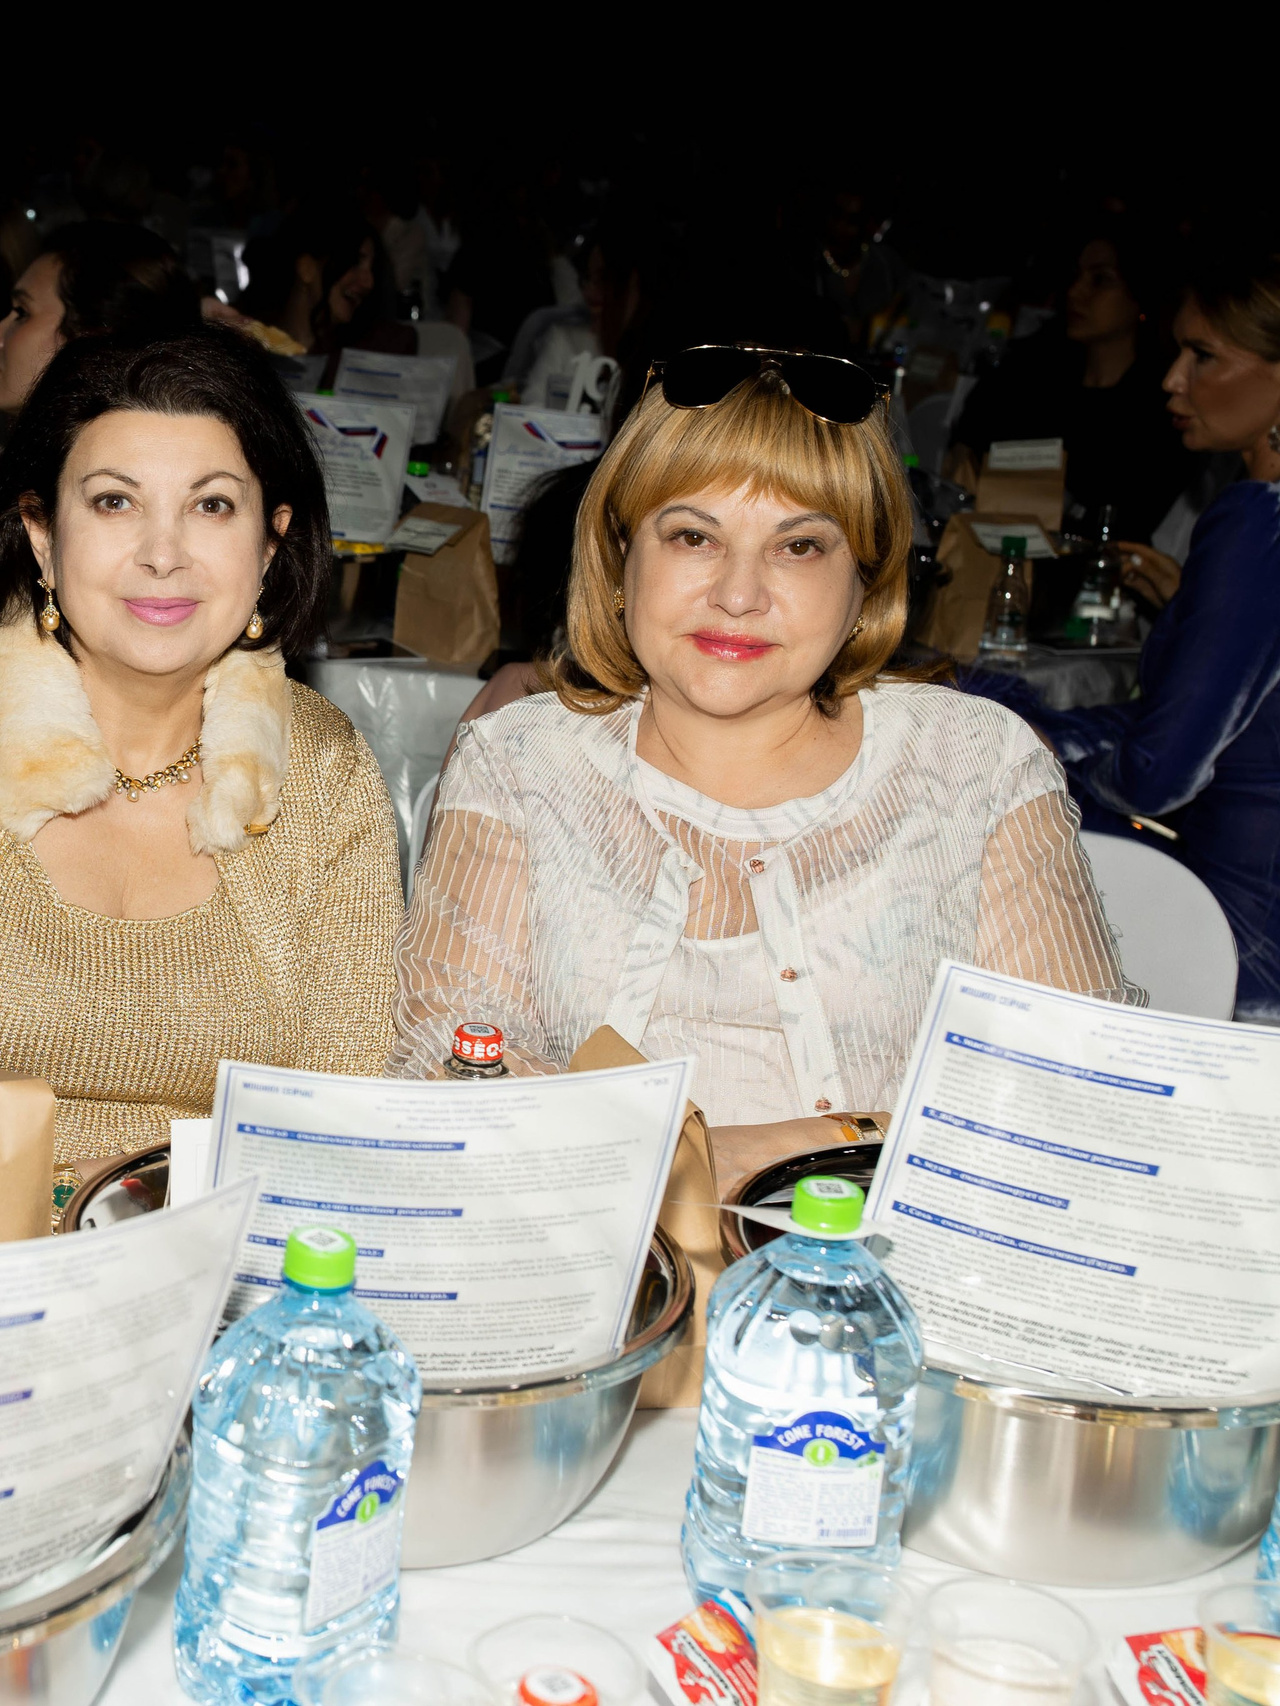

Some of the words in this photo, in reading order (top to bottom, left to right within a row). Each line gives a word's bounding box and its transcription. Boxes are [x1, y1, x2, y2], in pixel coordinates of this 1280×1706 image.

[777, 1424, 813, 1447] CONE
[815, 1424, 866, 1451] FOREST
[336, 1485, 363, 1518] CONE
[364, 1474, 397, 1493] FOREST
